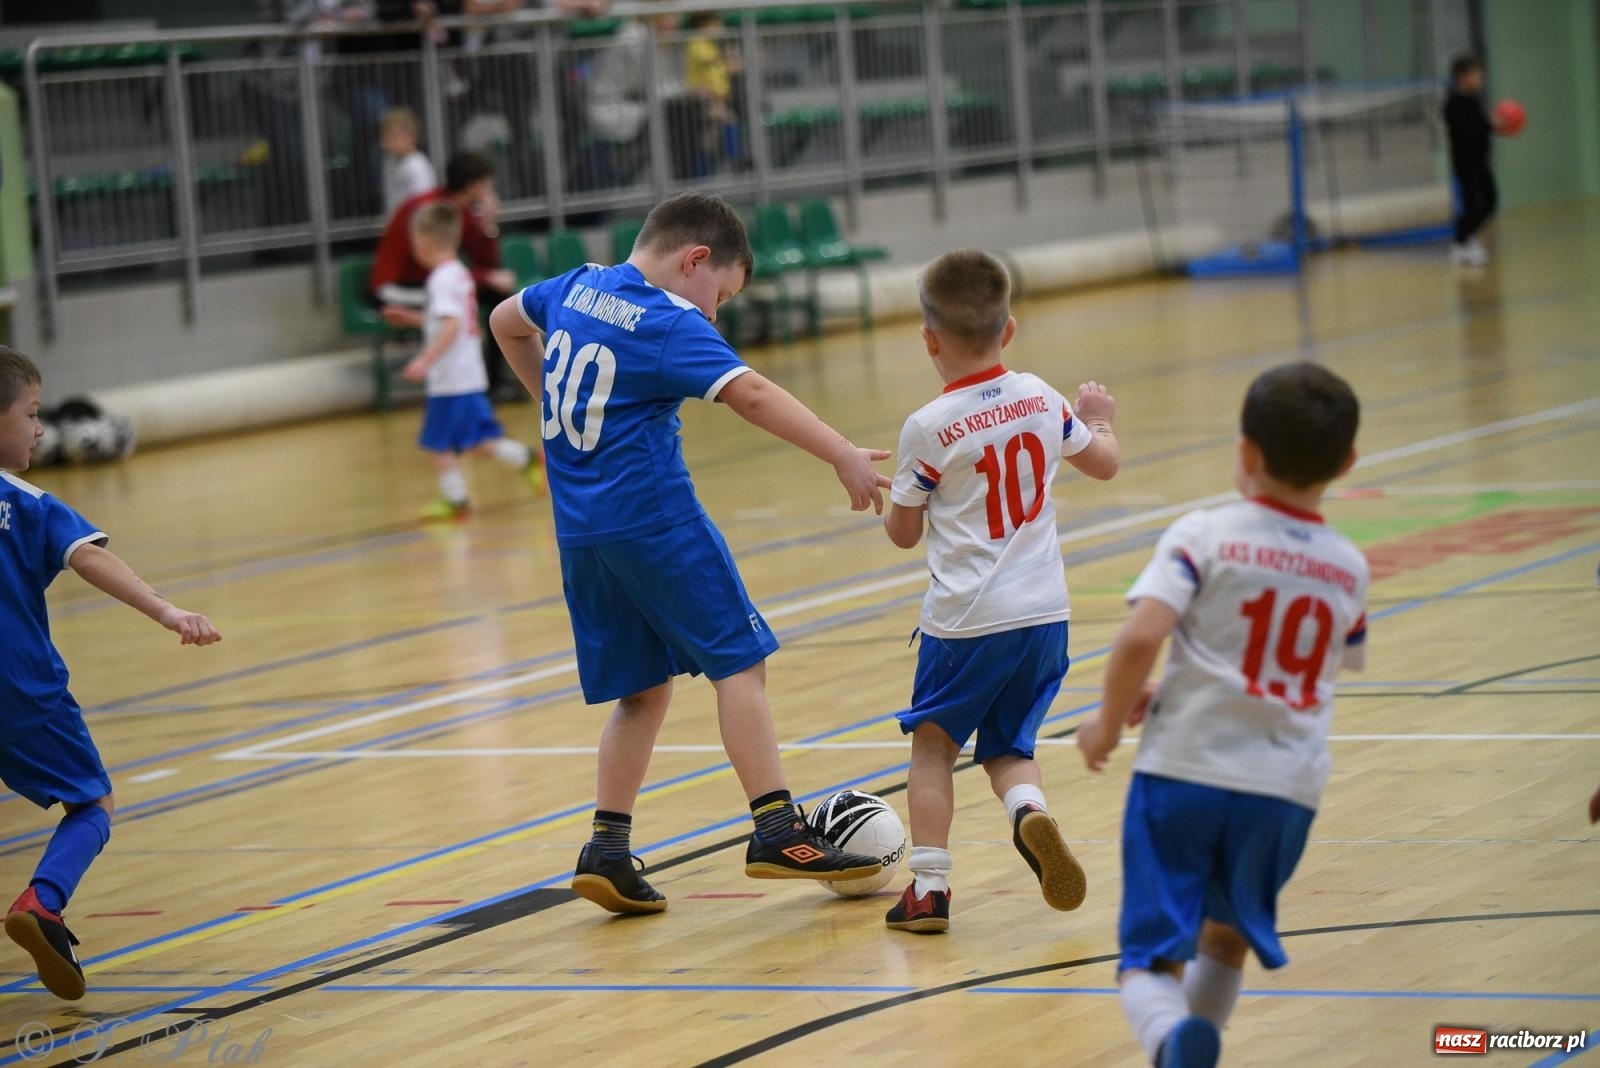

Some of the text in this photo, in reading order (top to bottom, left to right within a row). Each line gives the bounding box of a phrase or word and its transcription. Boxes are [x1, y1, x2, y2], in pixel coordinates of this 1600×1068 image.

[590, 291, 647, 333] MARKOWICE
[541, 330, 617, 451] 30
[937, 396, 1049, 447] LKS KRZYŻANOWICE
[981, 387, 1002, 401] 1920
[974, 432, 1046, 539] 10
[1240, 587, 1333, 711] 19
